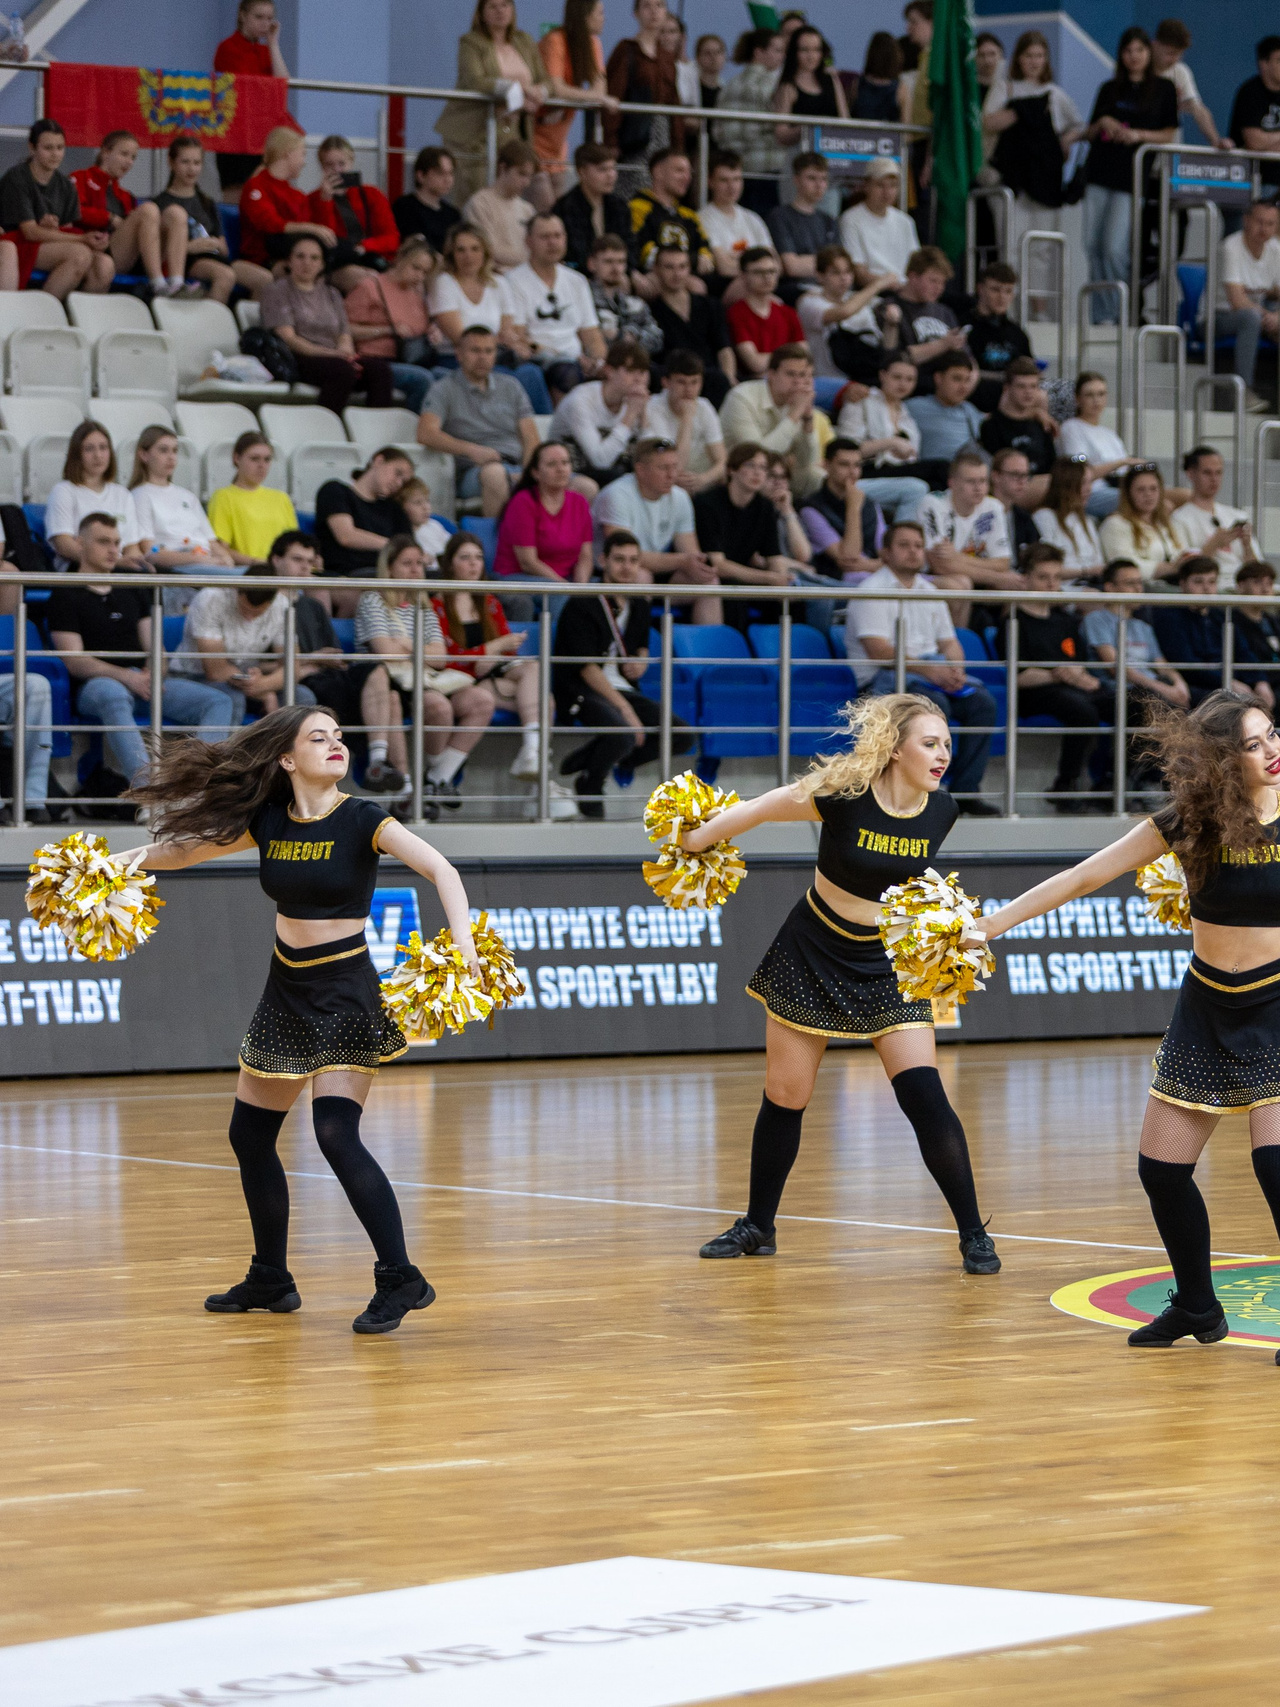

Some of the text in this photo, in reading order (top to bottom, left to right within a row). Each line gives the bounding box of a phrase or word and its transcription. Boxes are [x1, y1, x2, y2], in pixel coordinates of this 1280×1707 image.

[266, 839, 335, 861] TIMEOUT
[857, 827, 930, 858] TIMEOUT
[626, 904, 723, 949] СПОРТ
[536, 962, 719, 1009] SPORT-TV.BY
[1005, 952, 1049, 995] НА
[524, 1592, 868, 1645] СЫРЫ
